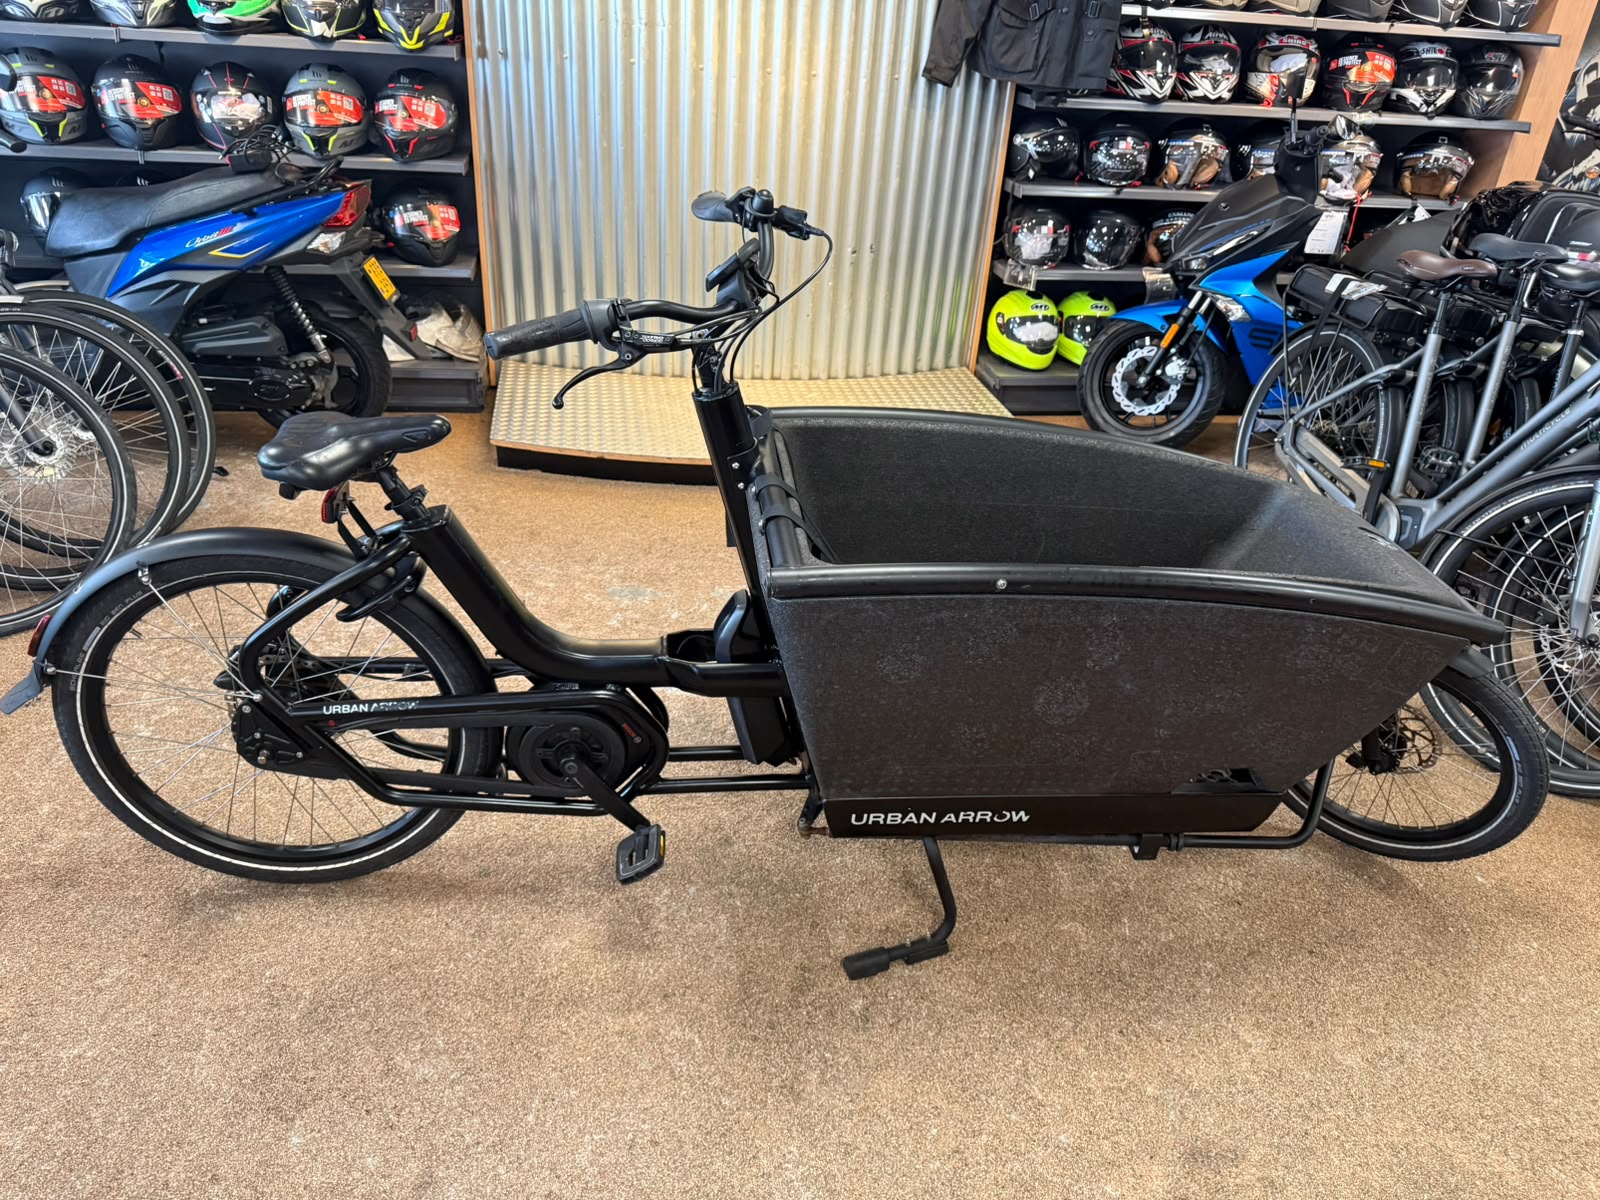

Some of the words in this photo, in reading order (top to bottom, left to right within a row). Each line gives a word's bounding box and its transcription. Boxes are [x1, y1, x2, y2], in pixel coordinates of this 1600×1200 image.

[322, 703, 369, 715] URBAN
[851, 812, 937, 826] URBAN
[940, 810, 1031, 824] ARROW
